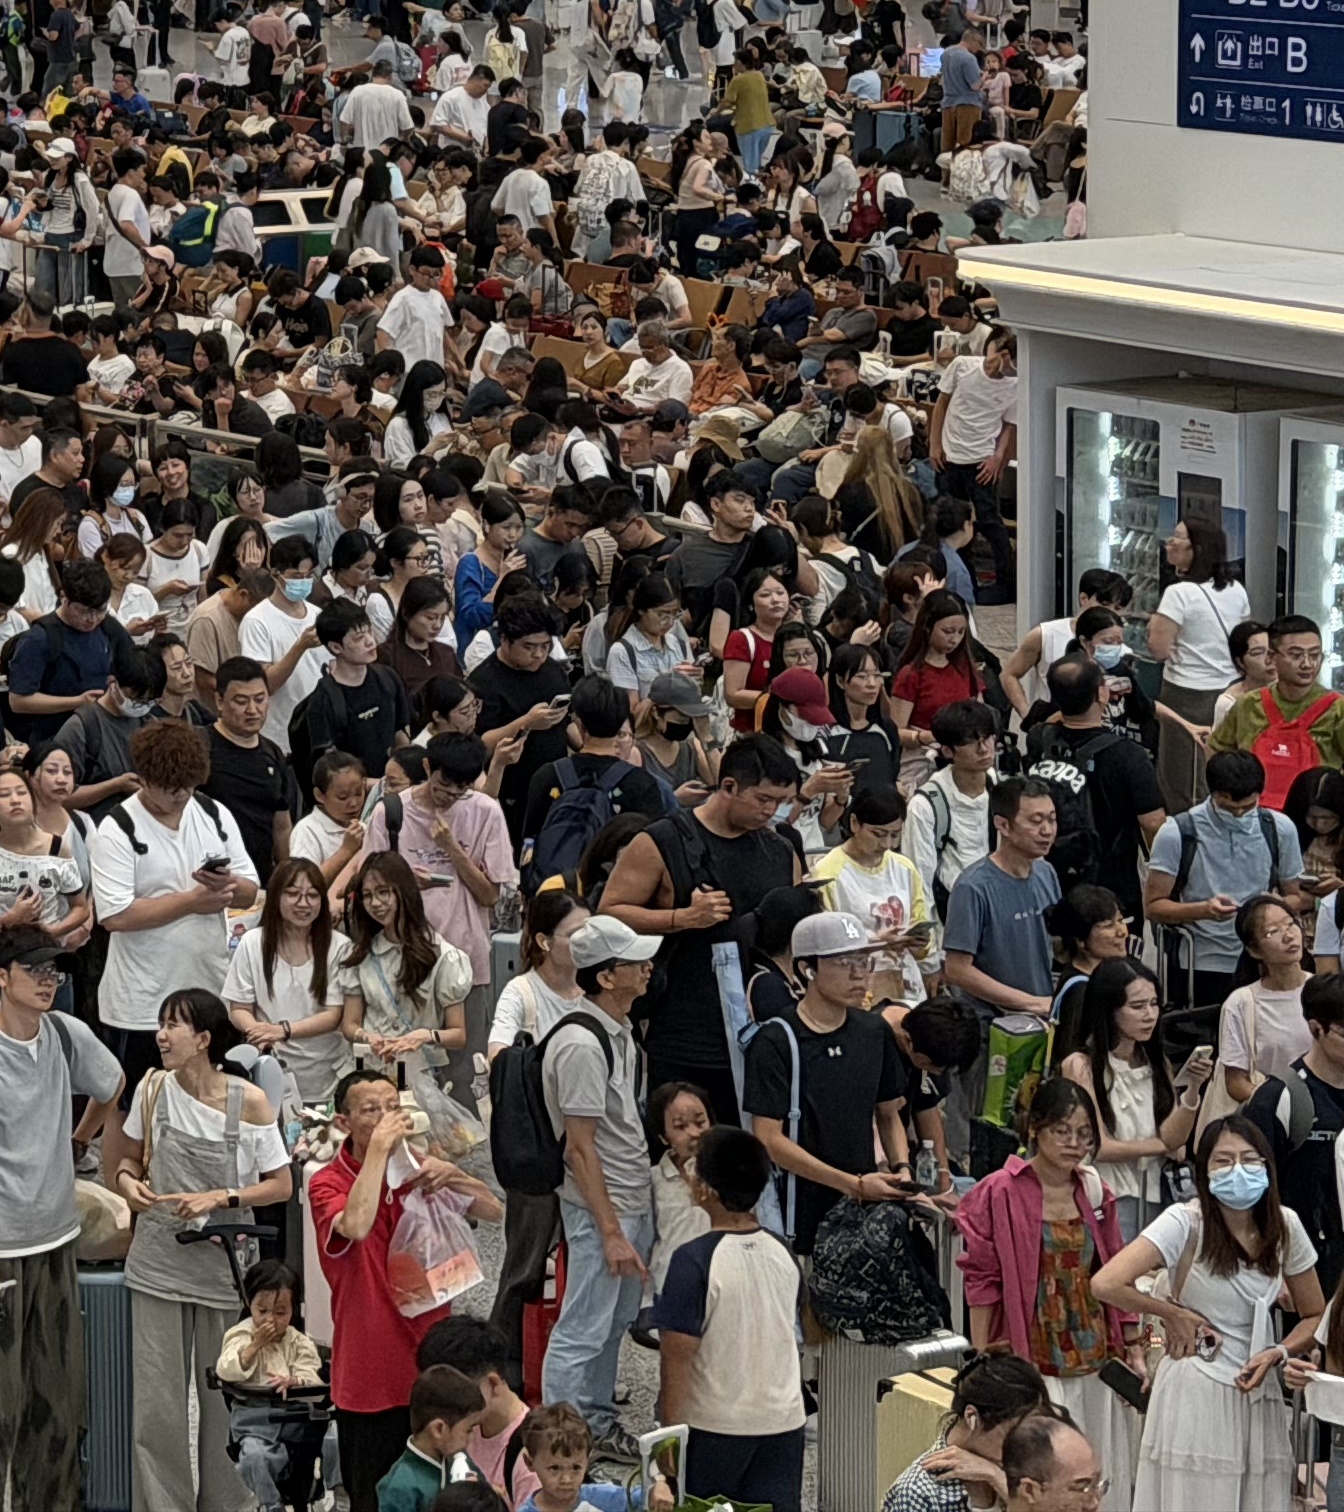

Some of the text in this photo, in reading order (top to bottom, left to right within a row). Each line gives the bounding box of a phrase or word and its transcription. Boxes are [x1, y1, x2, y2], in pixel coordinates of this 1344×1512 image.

[1248, 34, 1308, 73] 出口 B
[1240, 94, 1276, 112] 检票口
